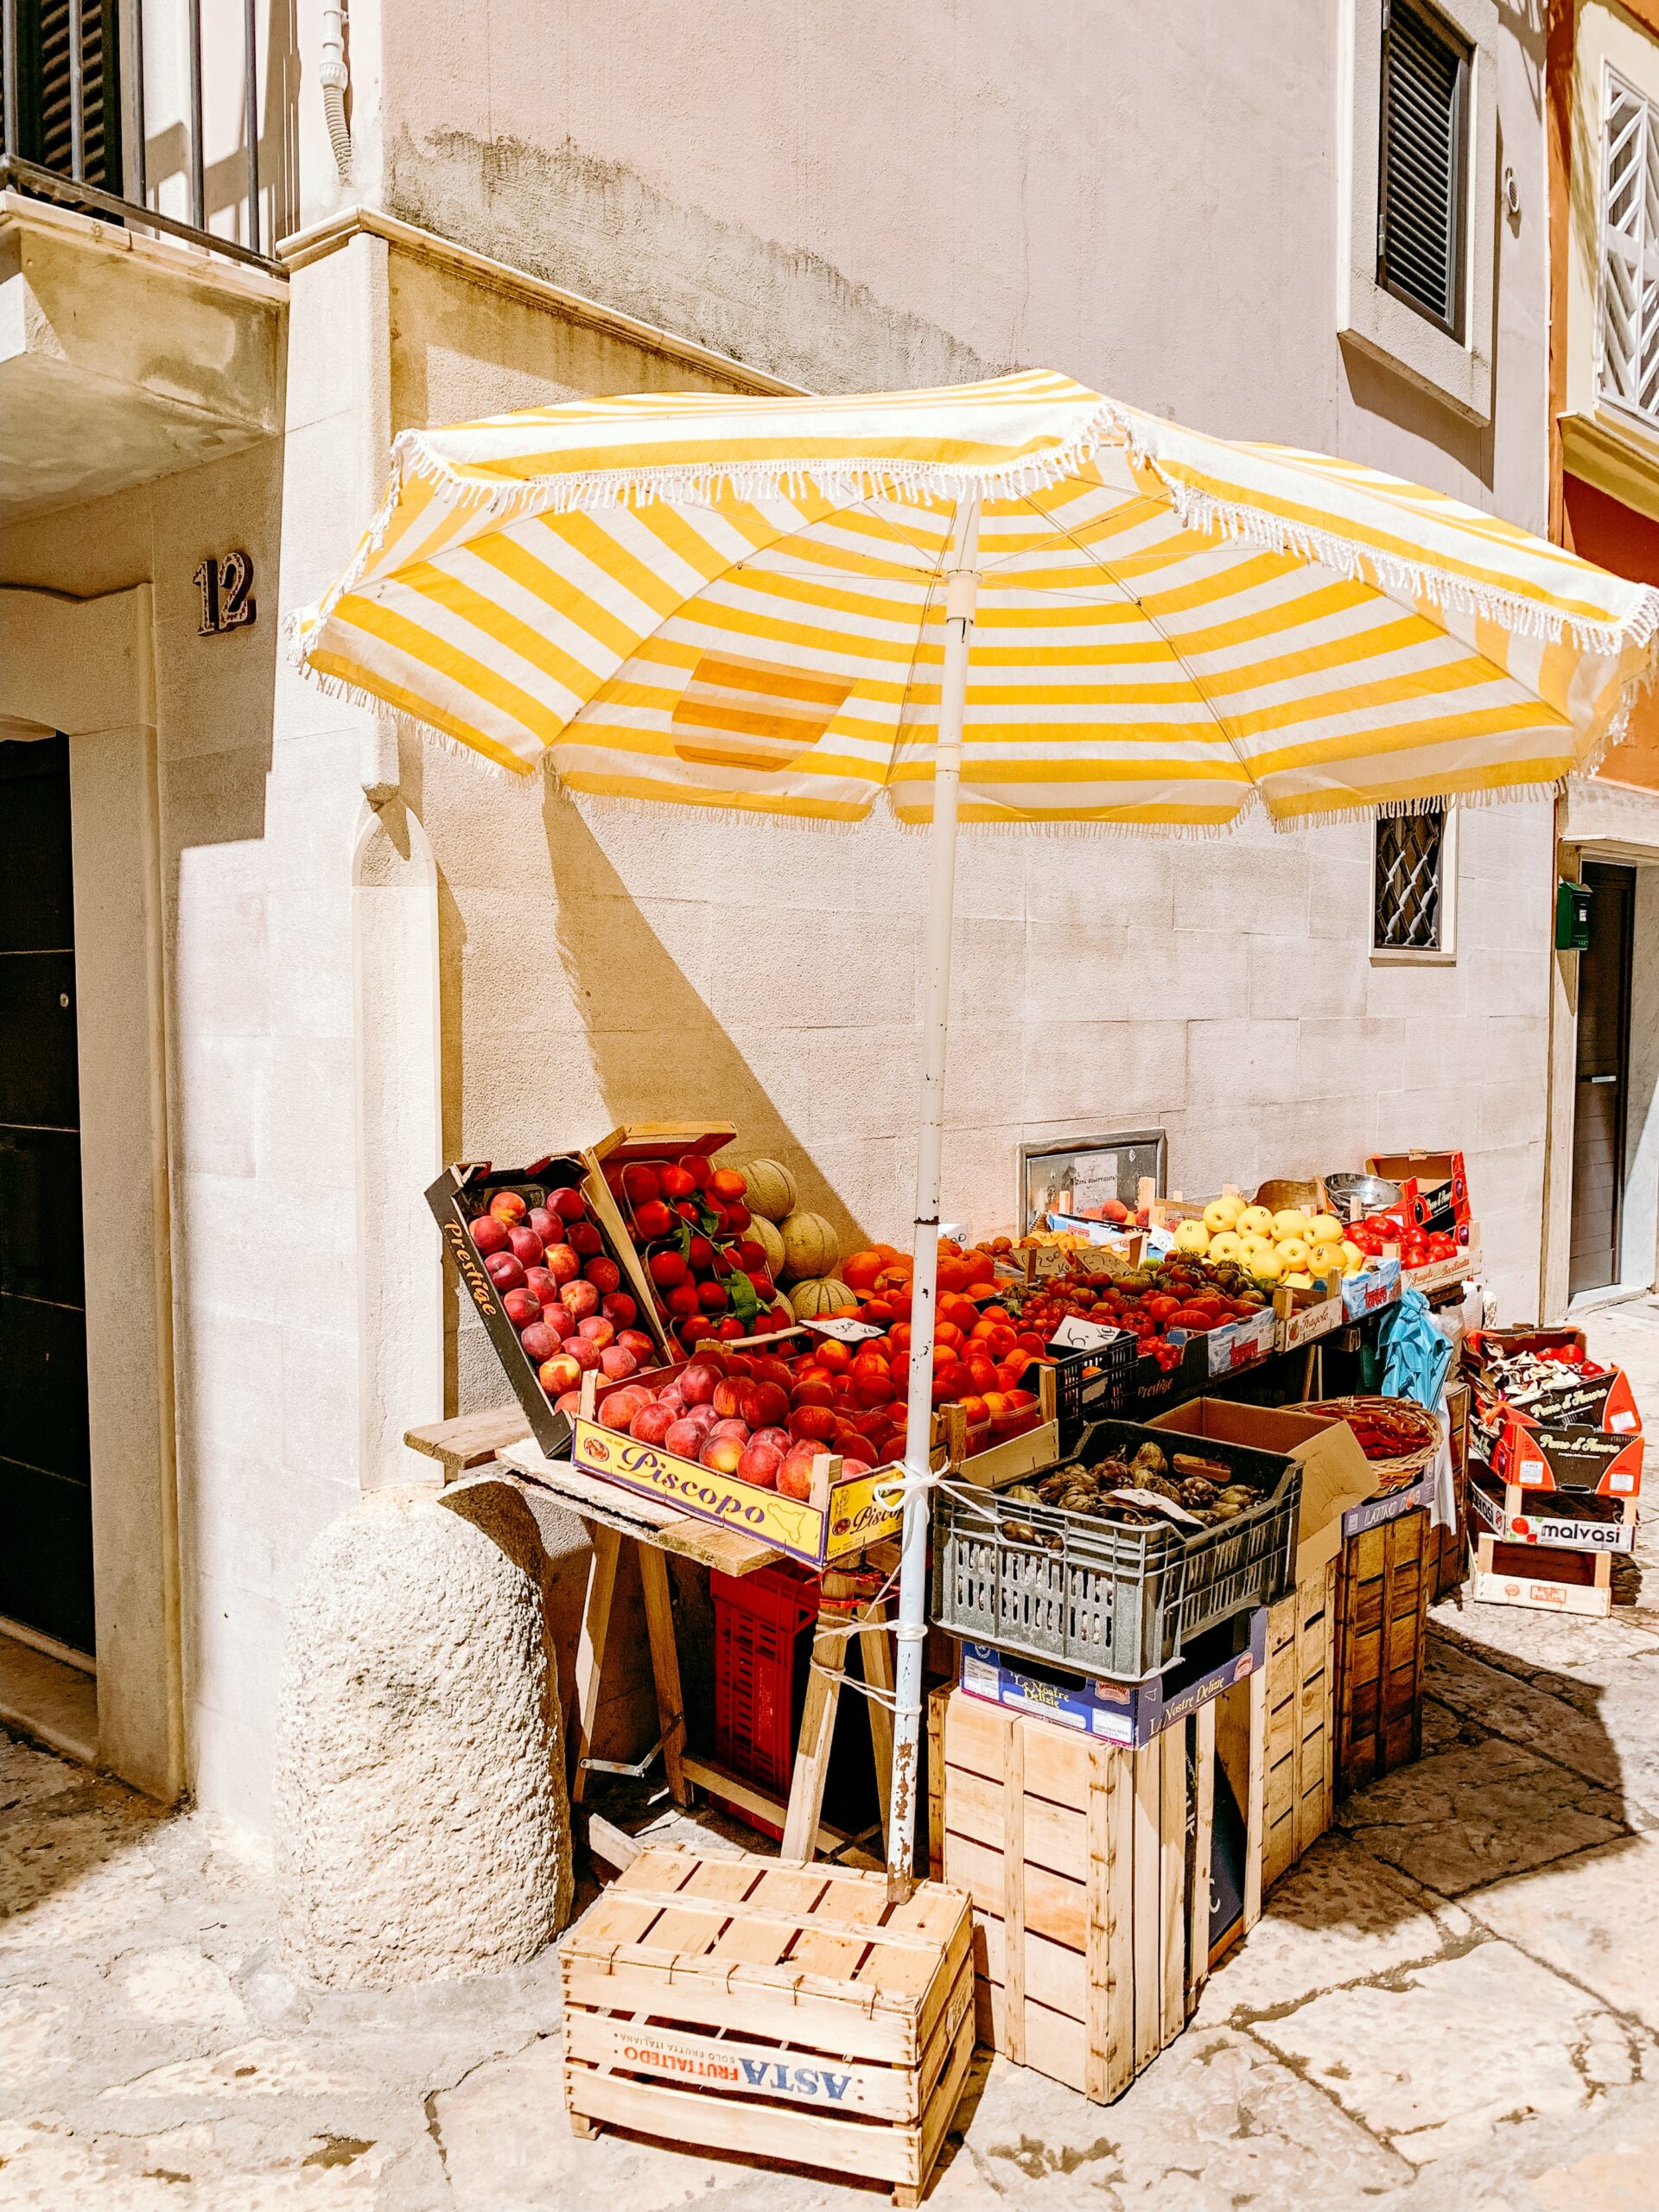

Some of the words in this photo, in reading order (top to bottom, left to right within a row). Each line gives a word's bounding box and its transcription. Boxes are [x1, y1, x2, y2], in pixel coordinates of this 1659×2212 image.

[193, 550, 257, 637] 12
[444, 1218, 497, 1315] Prestige
[616, 1446, 766, 1523] Piscopo
[1541, 1523, 1621, 1544] malvasi
[1023, 1688, 1060, 1710] Delizie
[1031, 1681, 1070, 1703] Nostre
[1196, 1675, 1225, 1704] Delizie
[620, 2033, 664, 2050] ITALIANA
[667, 2044, 705, 2058] FRUTTA
[709, 2052, 735, 2063] SOLO
[739, 2056, 852, 2101] ASTA
